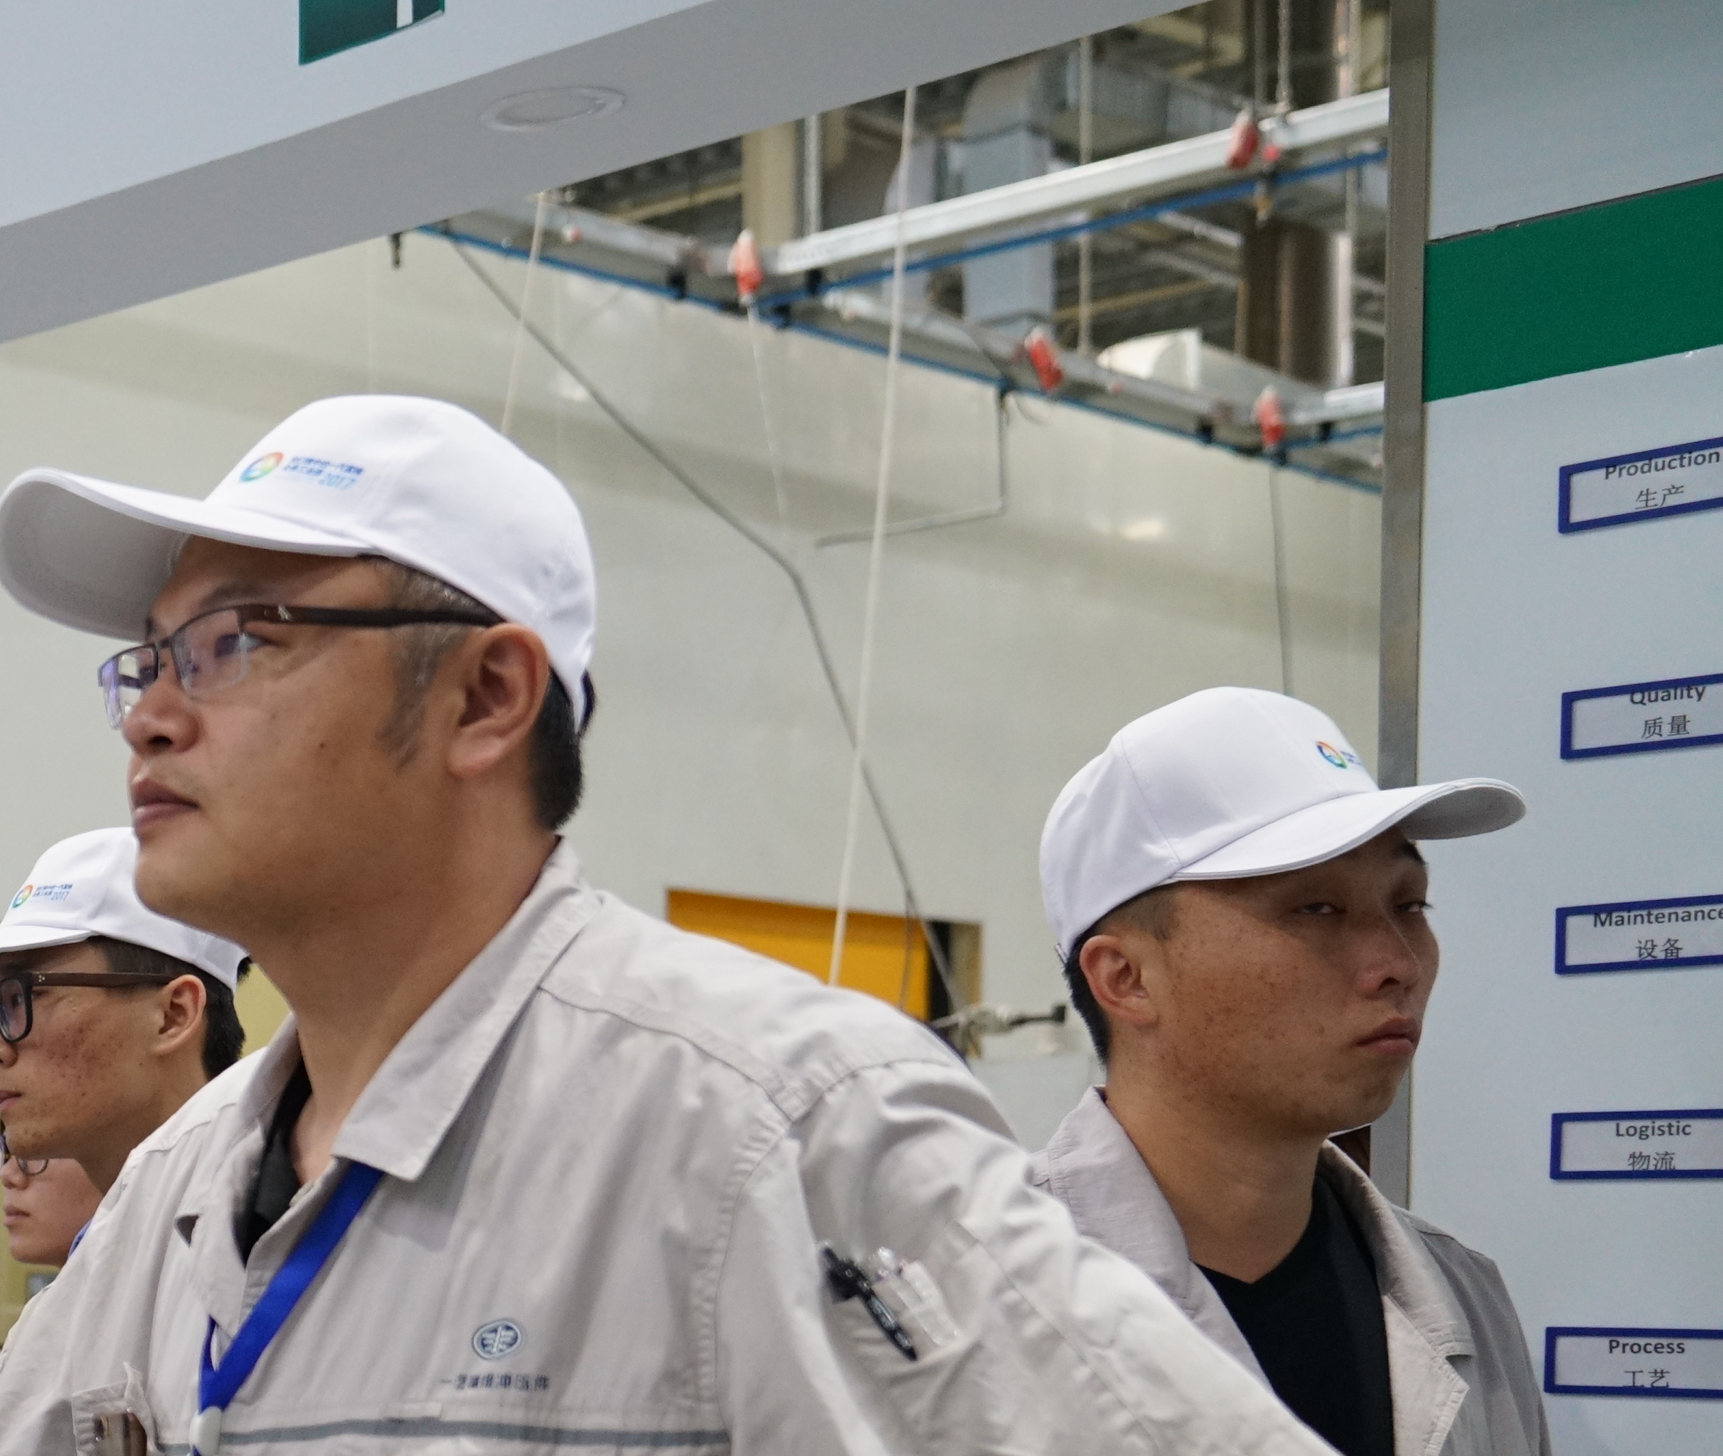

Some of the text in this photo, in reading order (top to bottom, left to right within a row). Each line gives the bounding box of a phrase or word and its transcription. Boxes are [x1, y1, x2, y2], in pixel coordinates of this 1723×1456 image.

[1604, 450, 1720, 480] Production
[1634, 484, 1685, 511] 生产
[1629, 685, 1706, 706] Quality
[1641, 714, 1691, 739] 质量
[1635, 937, 1683, 961] 设备
[1615, 1121, 1692, 1140] Logistic
[1627, 1151, 1677, 1171] 物流
[1608, 1339, 1686, 1355] Process
[1623, 1368, 1671, 1389] 工艺
